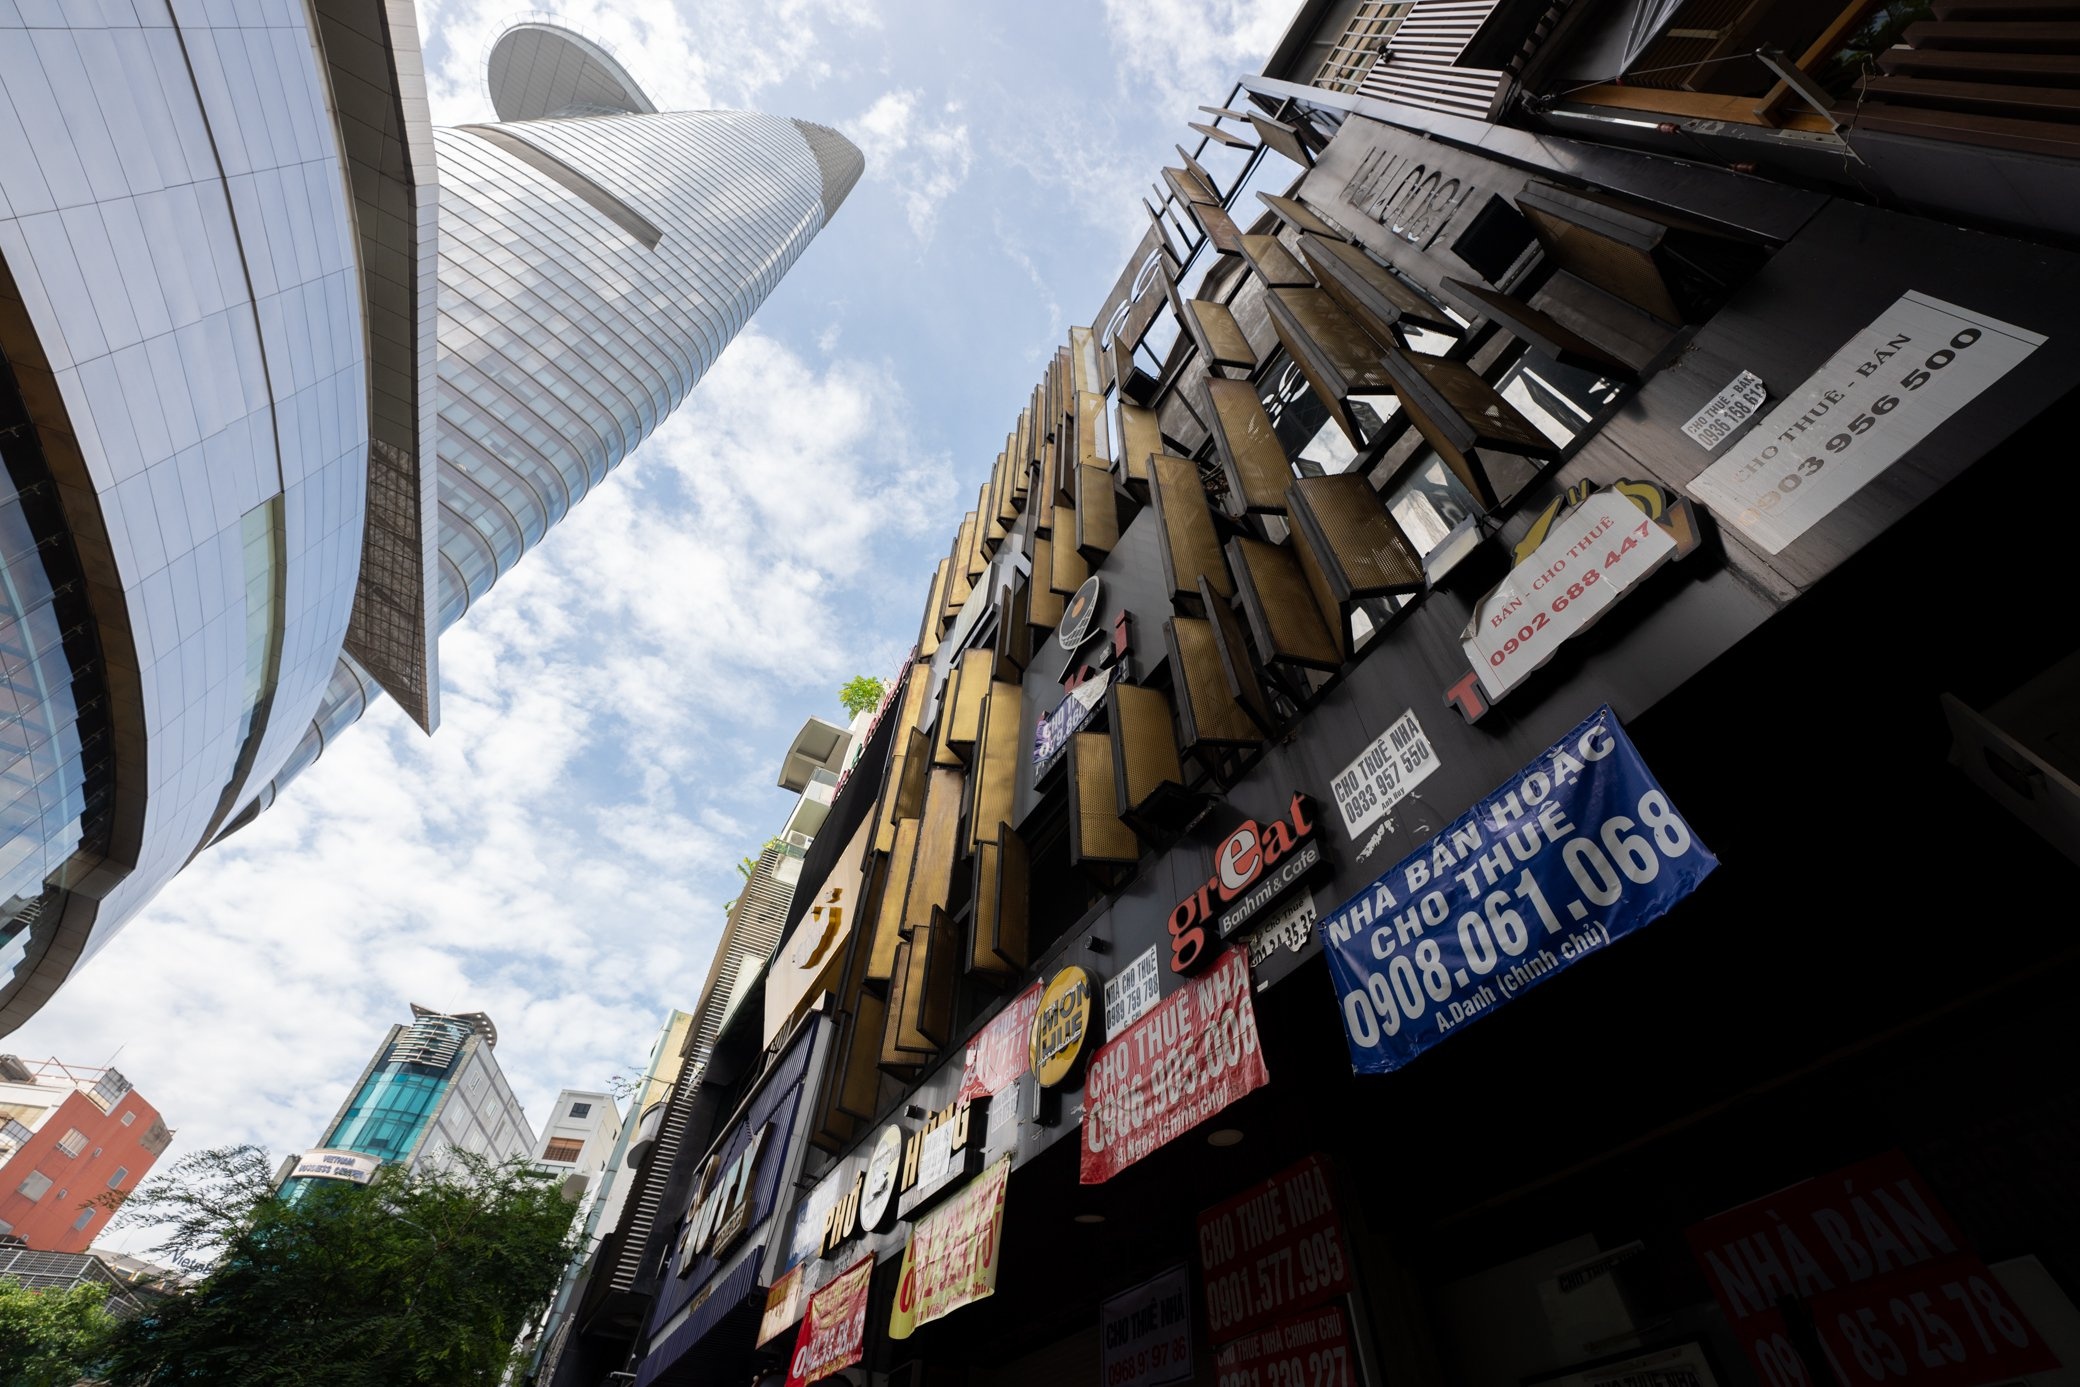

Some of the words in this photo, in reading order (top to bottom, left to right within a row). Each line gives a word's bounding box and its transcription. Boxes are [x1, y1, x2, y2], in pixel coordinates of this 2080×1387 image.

[1699, 415, 1731, 448] 0936
[1706, 394, 1729, 418] THUÊ
[1778, 387, 1847, 444] THUÊ
[1856, 332, 1914, 379] BÁN
[1824, 393, 1901, 455] 956
[1899, 326, 1984, 393] 500
[1489, 611, 1551, 668] 0902
[1551, 568, 1602, 614] 688
[1603, 519, 1652, 570] 447
[1490, 598, 1524, 629] BÁN
[1532, 558, 1567, 592] CHO
[1565, 515, 1615, 561] THUÊ
[1334, 769, 1360, 804] CHO
[1357, 738, 1392, 782] THUÊ
[1389, 713, 1420, 753] NHÀ
[1344, 783, 1378, 825] 0933
[1375, 759, 1401, 797] 957
[1400, 737, 1430, 774] 550
[1167, 790, 1314, 973] great
[1272, 877, 1284, 892] &
[1282, 848, 1317, 883] Cafe
[1329, 881, 1398, 950] NHÀ
[1403, 817, 1483, 895] BÁN
[1480, 724, 1616, 834] HOẶC
[1369, 890, 1450, 961] CHO
[1455, 800, 1578, 900] THUÊ
[1343, 788, 1692, 1049] 0908.061.068
[1089, 1040, 1129, 1099] CHO
[1134, 987, 1193, 1066] THUÊ
[1199, 947, 1249, 1022] NHÀ
[1105, 976, 1120, 1006] NHÀ
[1121, 969, 1136, 993] CHO
[1136, 947, 1158, 980] THUÊ
[1106, 1003, 1125, 1031] 0989
[1127, 990, 1142, 1013] 759
[1142, 975, 1160, 1005] 798
[1434, 984, 1498, 1035] A.Danh
[1497, 946, 1556, 1001] (chính
[1559, 919, 1612, 962] chủ)
[1088, 994, 1257, 1153] 0906.905.006
[1200, 1213, 1236, 1271] CHO
[1235, 1178, 1286, 1253] THUÊ
[1284, 1155, 1333, 1229] NHÀ
[1704, 1207, 1838, 1320] NHÀ
[1809, 1176, 1962, 1285] BÁN
[1106, 1316, 1129, 1350] CHO
[1131, 1297, 1158, 1340] THUÊ
[1160, 1286, 1185, 1329] NHÀ
[1206, 1225, 1345, 1333] 0901.577.995
